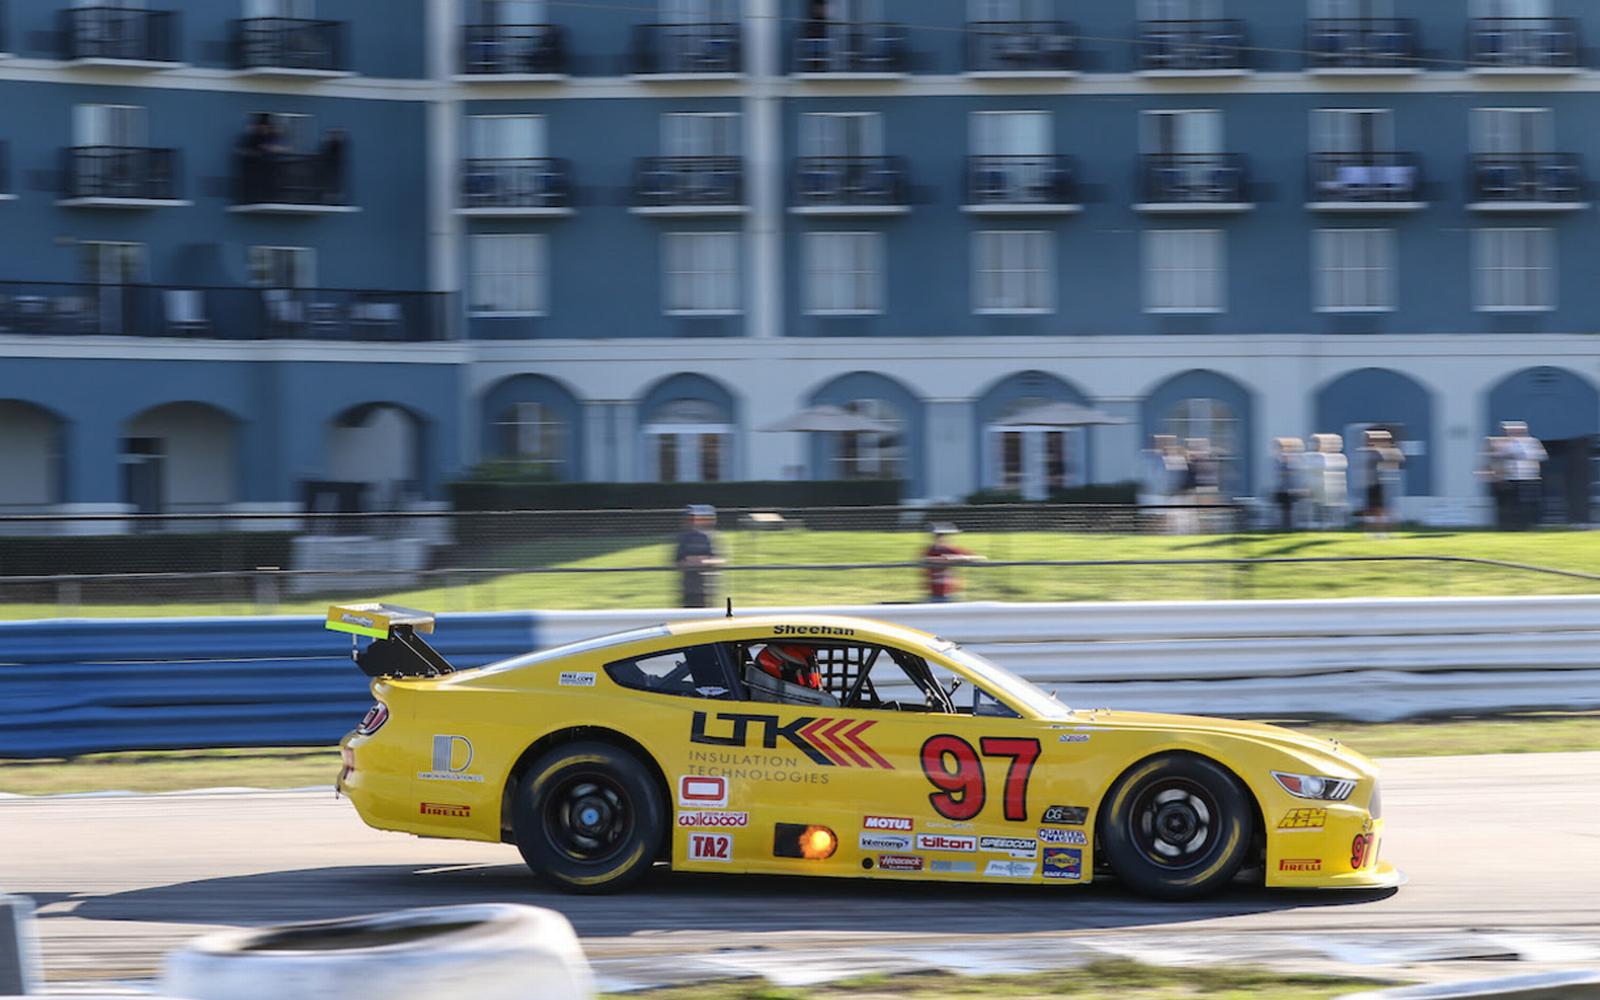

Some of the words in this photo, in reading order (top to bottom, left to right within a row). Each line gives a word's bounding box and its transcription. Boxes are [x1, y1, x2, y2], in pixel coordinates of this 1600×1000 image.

[773, 624, 855, 636] Sheehan
[690, 711, 836, 766] LTK
[688, 751, 797, 767] INSULATION
[688, 764, 830, 784] TECHNOLOGIES
[919, 733, 1042, 822] 97
[420, 802, 471, 817] PIRELLI
[678, 811, 748, 826] wilwood
[865, 817, 912, 830] MOTUL
[1277, 807, 1329, 829] AEM
[1039, 828, 1086, 839] QUARTER
[1047, 835, 1086, 845] MASTER
[693, 836, 729, 859] TA2
[862, 838, 904, 850] Intercomp
[920, 836, 974, 850] tilton
[981, 839, 1036, 849] SPEEDCOM
[1279, 858, 1322, 872] PIRELLI
